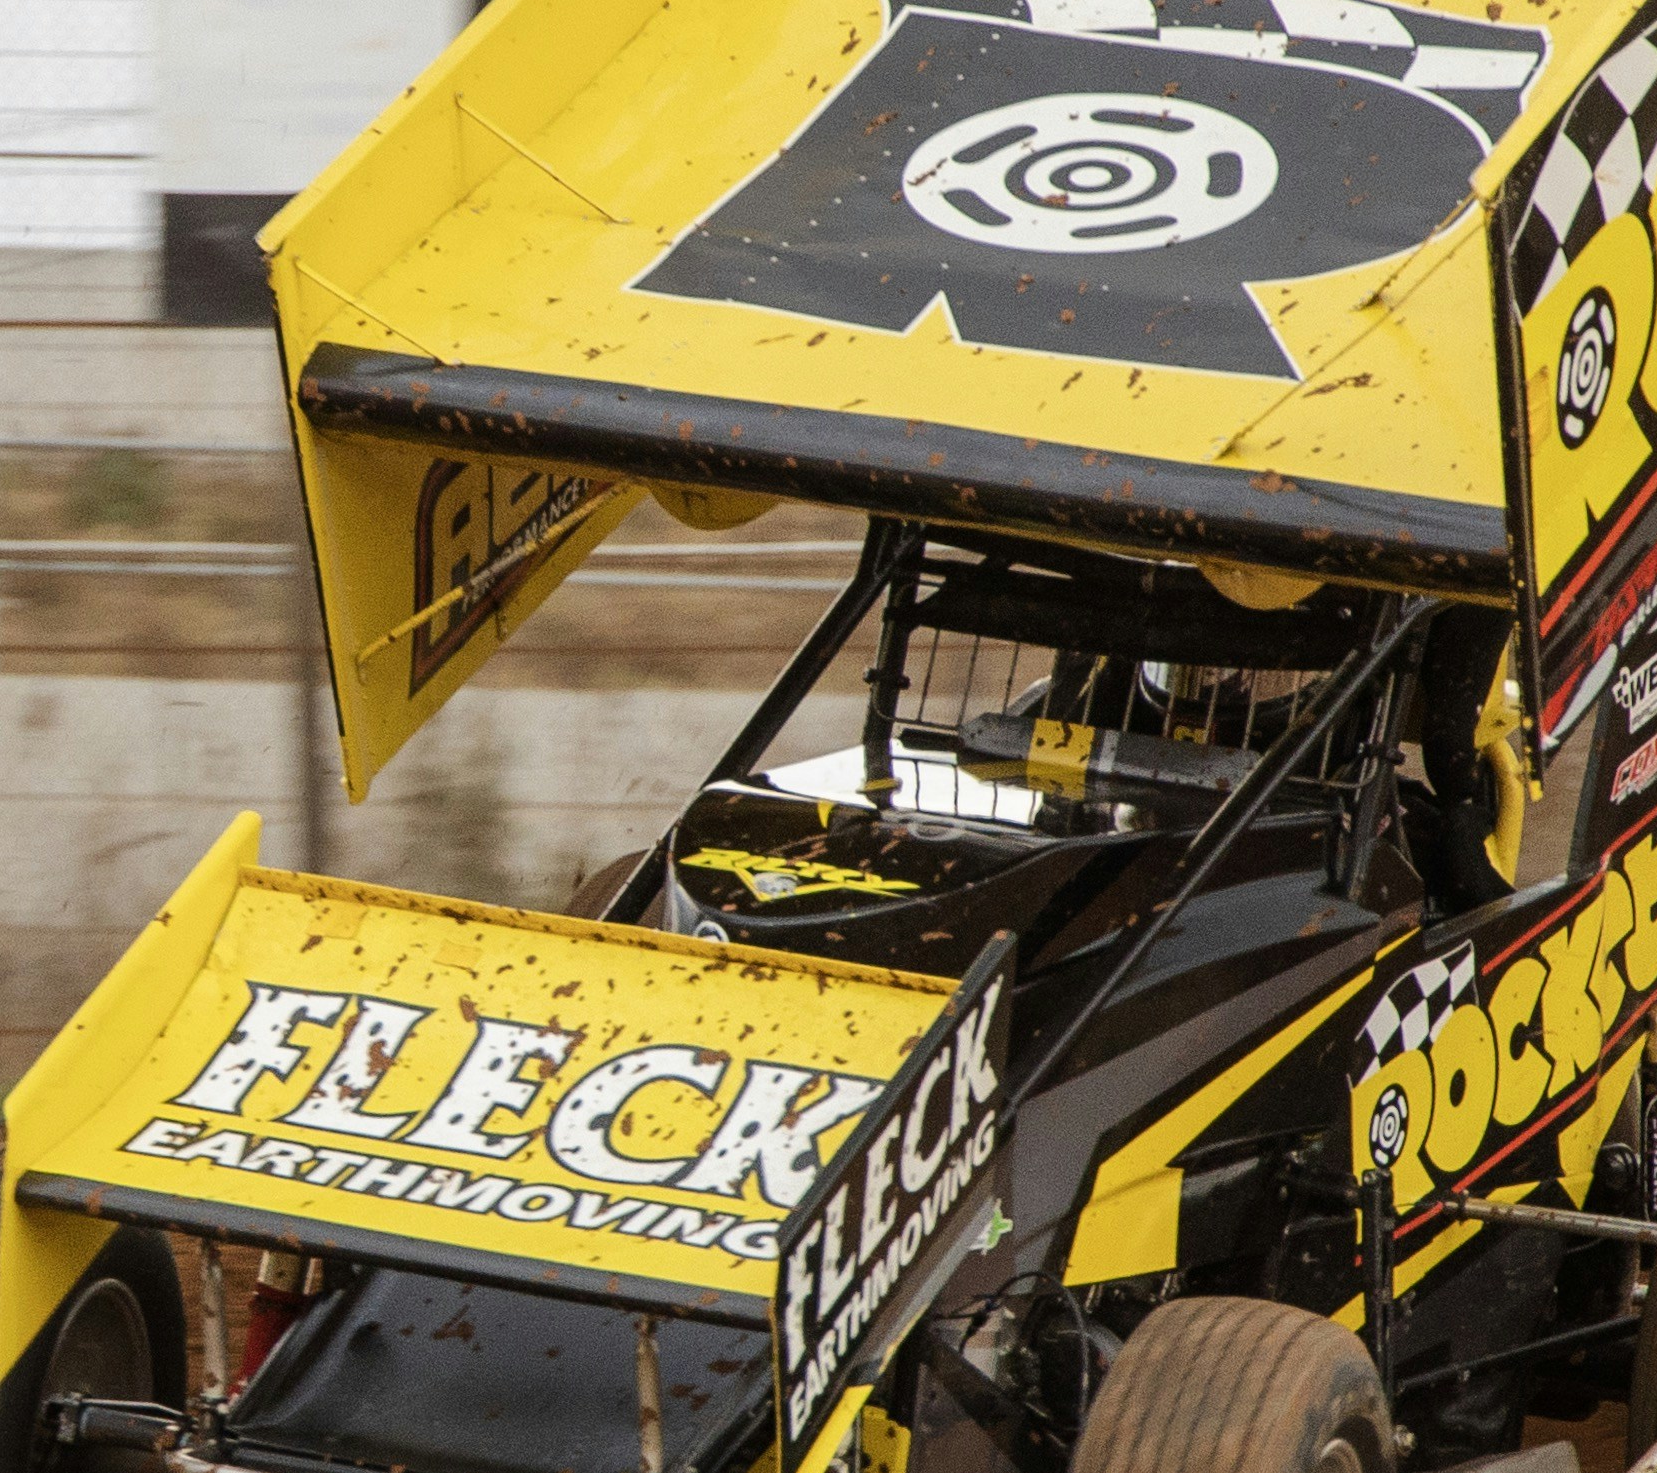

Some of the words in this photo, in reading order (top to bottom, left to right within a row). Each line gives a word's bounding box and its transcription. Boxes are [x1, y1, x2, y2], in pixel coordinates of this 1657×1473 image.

[119, 1116, 784, 1262] EARTHMOVING
[168, 978, 885, 1210] FLECK
[786, 974, 1003, 1375] FLECK
[788, 1108, 996, 1444] EARTHMOVING
